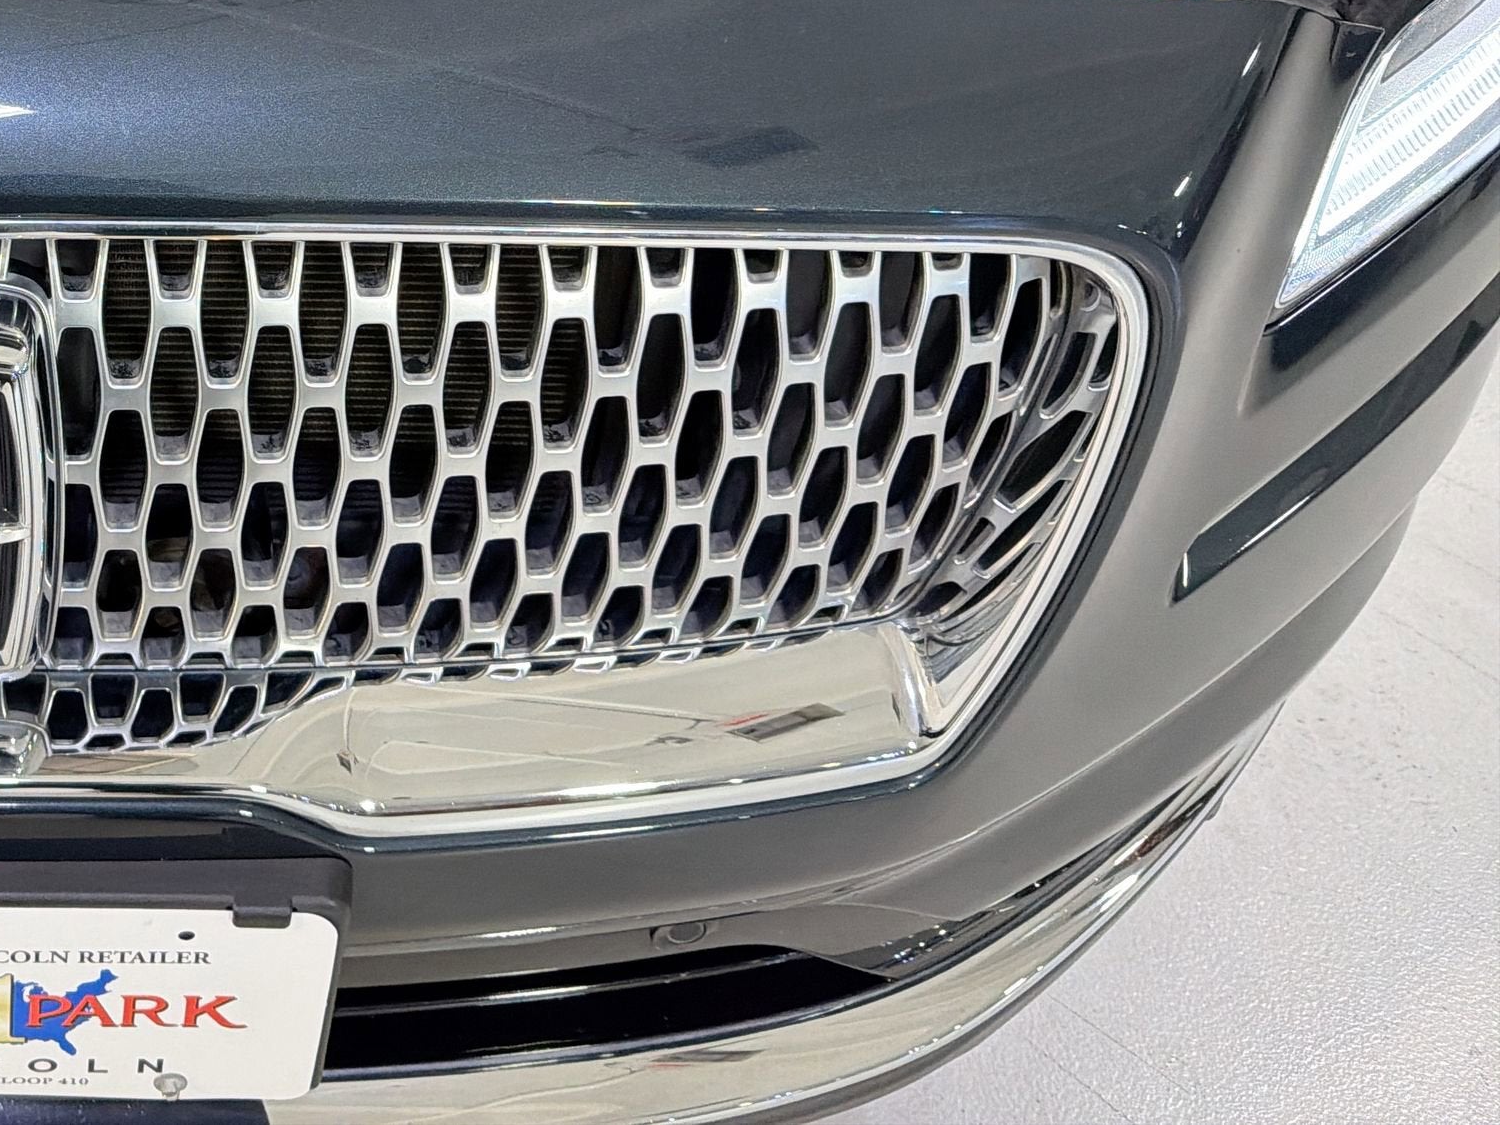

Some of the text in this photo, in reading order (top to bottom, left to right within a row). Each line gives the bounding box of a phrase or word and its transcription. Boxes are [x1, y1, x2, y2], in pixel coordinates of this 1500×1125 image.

[78, 950, 212, 965] RETAILER
[25, 994, 248, 1029] PARK
[1, 1076, 54, 1085] LOOP
[58, 1076, 90, 1086] 410
